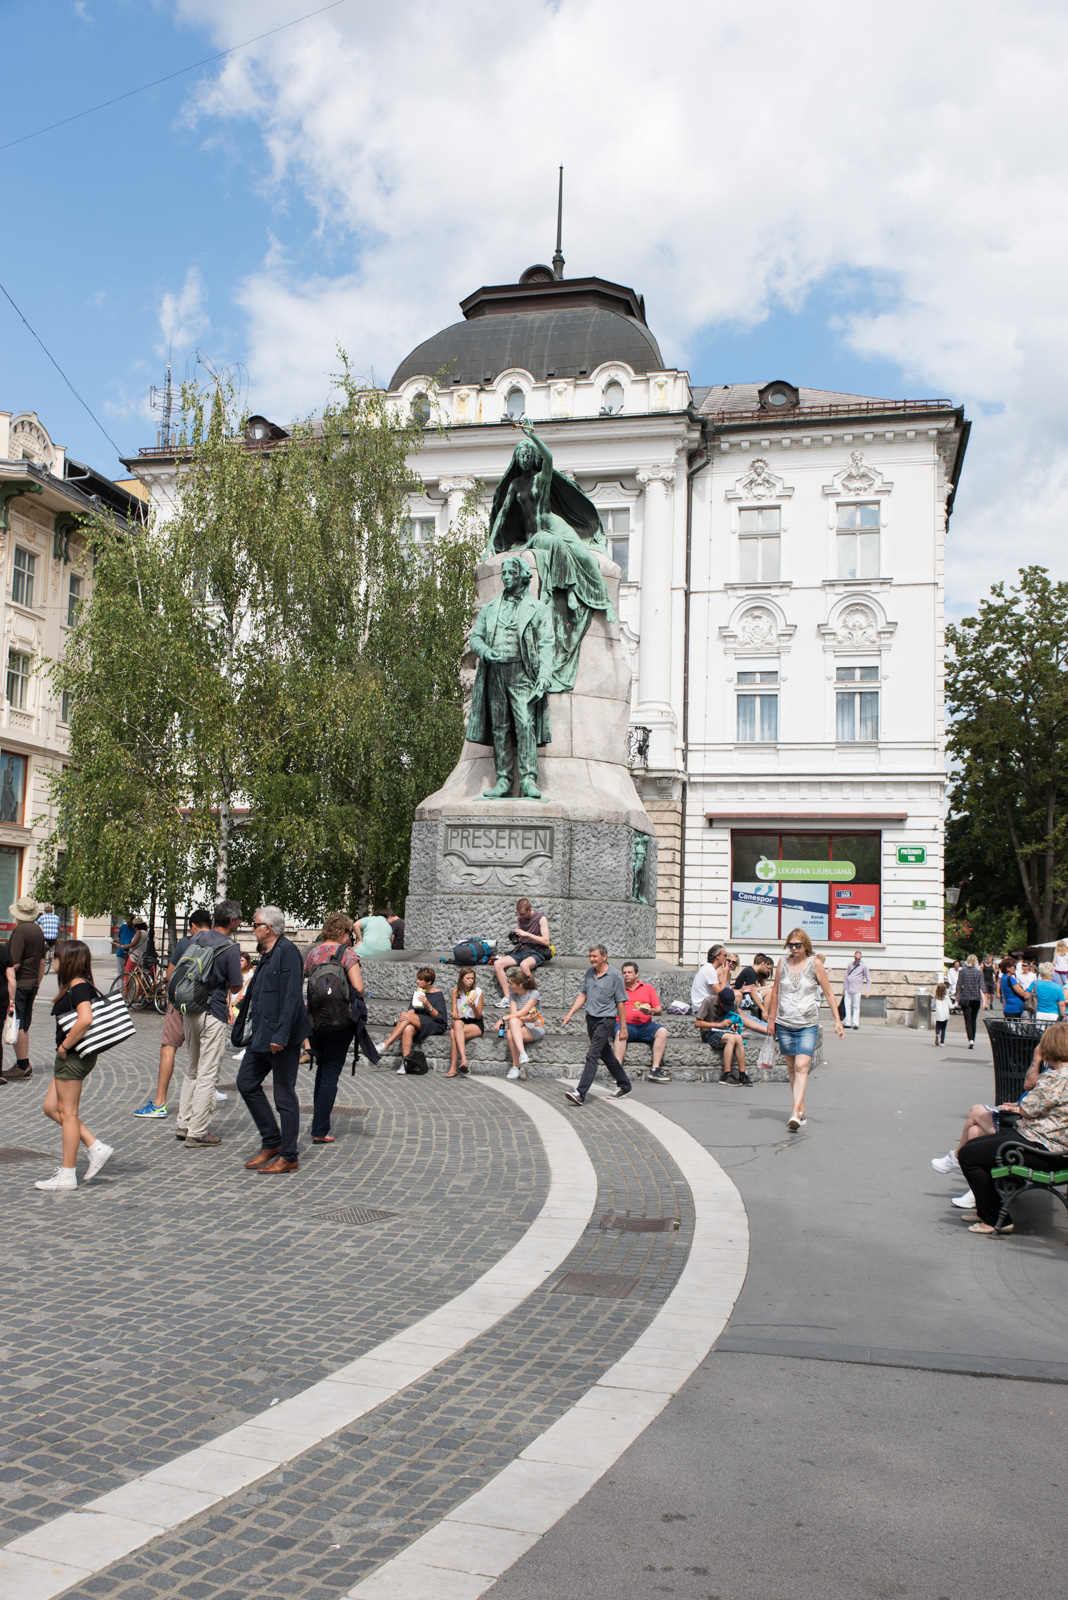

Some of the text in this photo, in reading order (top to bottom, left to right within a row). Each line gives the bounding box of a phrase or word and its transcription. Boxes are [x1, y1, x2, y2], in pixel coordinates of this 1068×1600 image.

[778, 867, 852, 875] LEKARNA LJUBLJANA
[738, 892, 773, 903] Canespor
